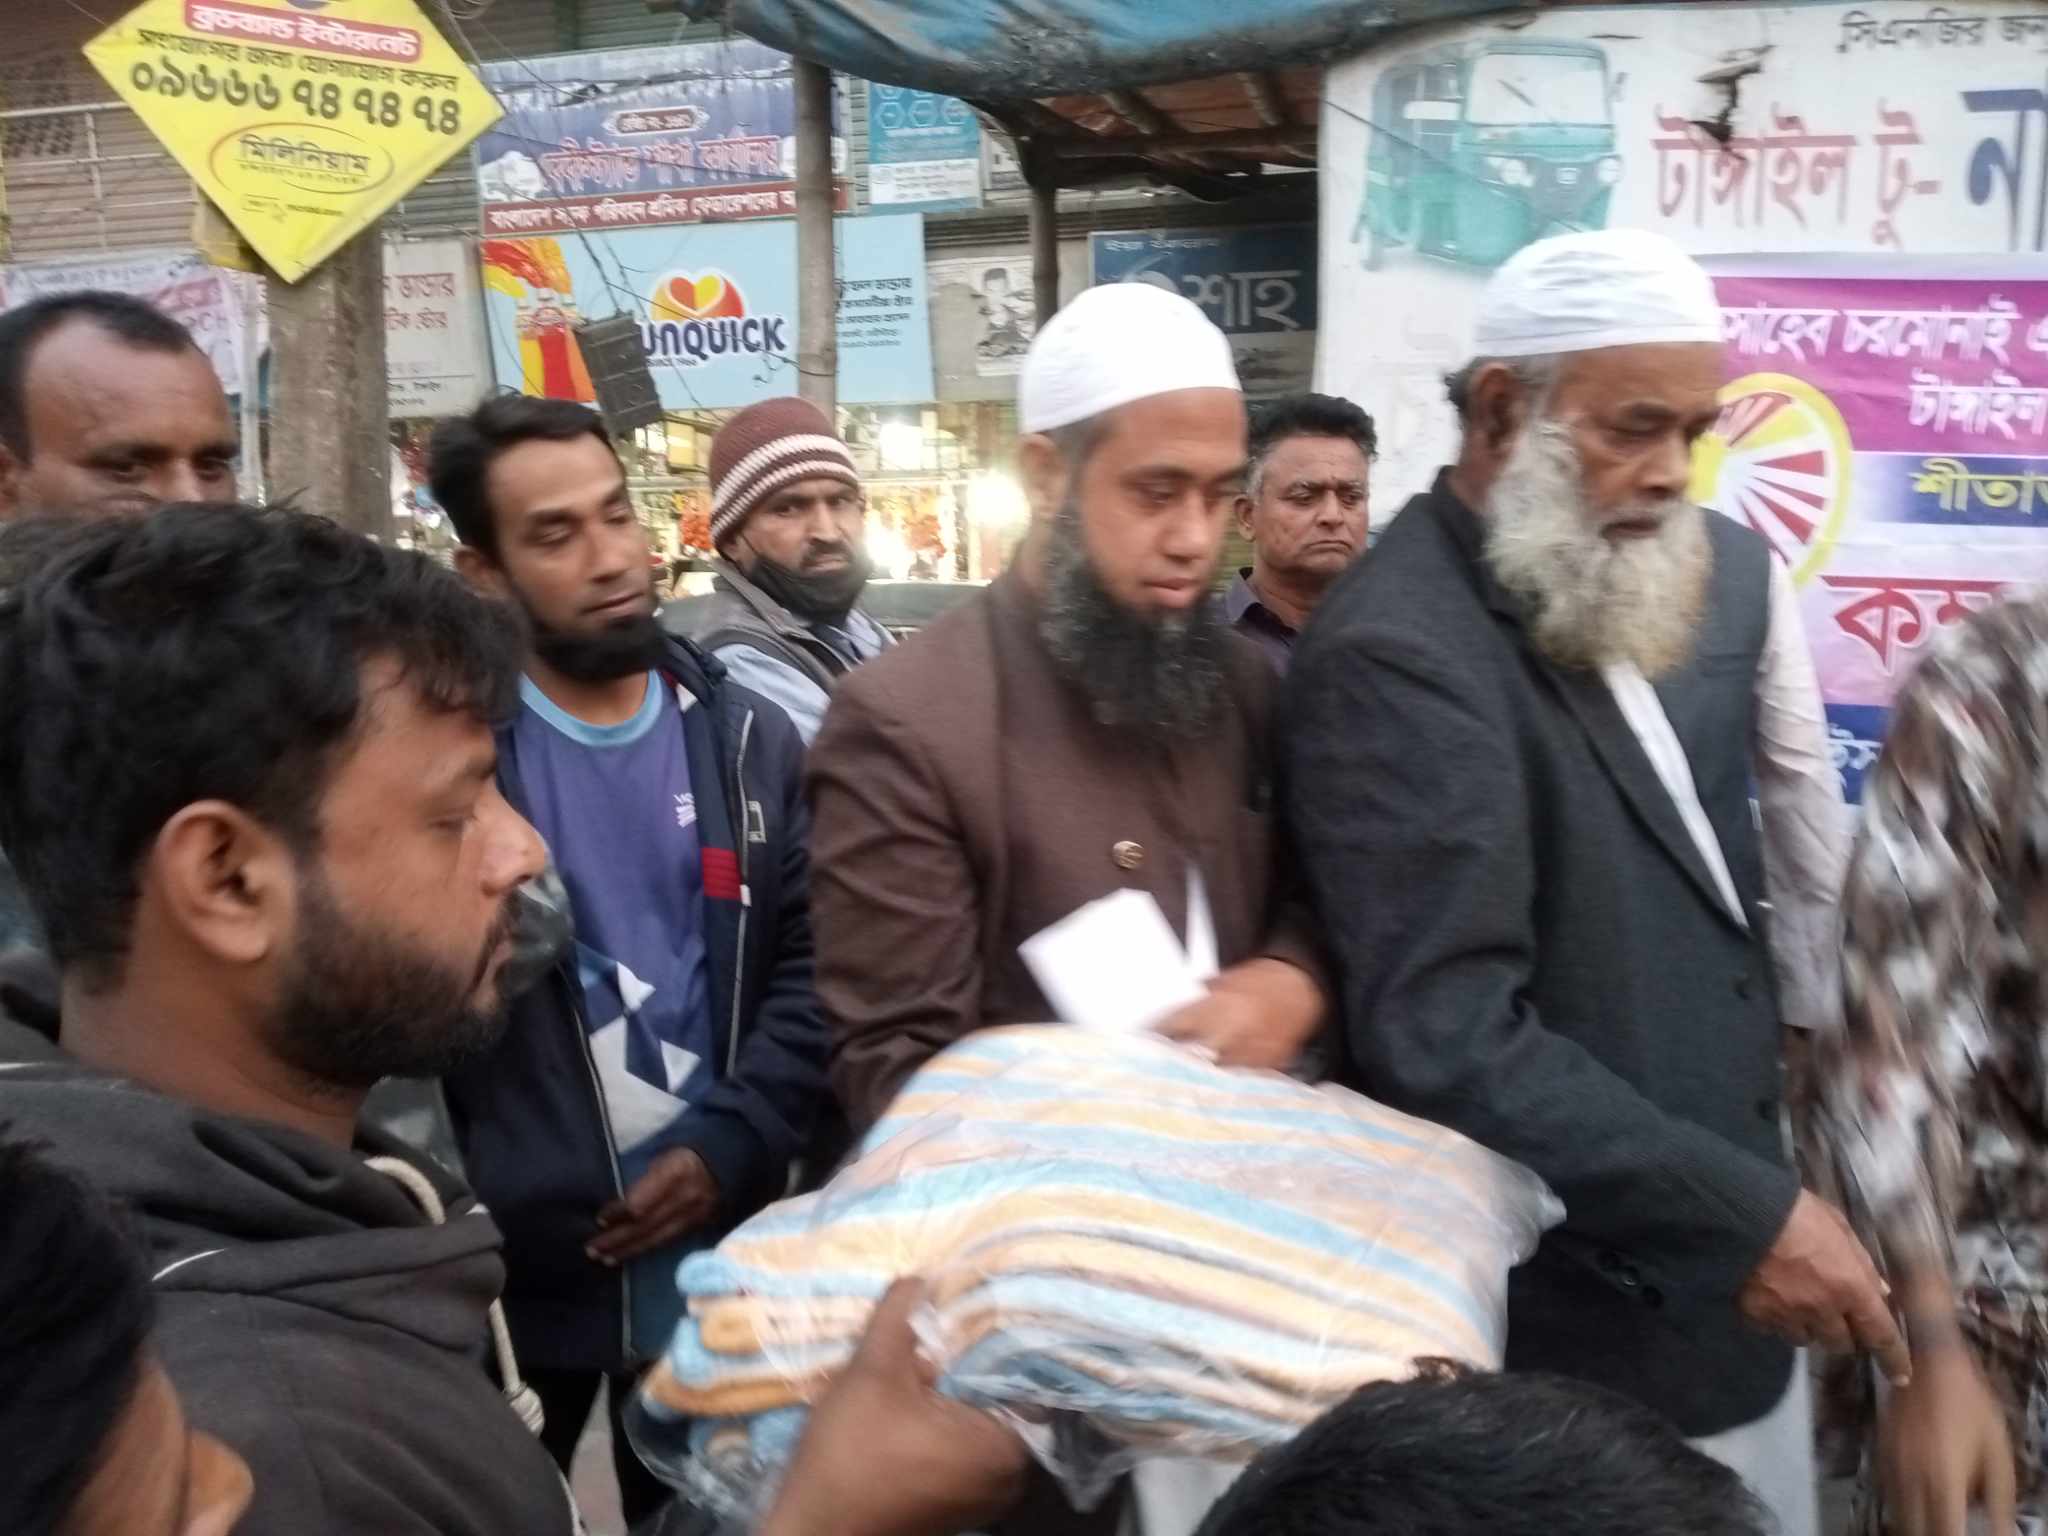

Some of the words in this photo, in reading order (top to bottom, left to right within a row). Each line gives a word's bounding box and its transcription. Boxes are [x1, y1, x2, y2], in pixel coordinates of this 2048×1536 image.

[131, 55, 281, 111] ০৯৬৬৬
[292, 79, 341, 120] ৭৪
[353, 87, 401, 128] ৭৪
[413, 95, 460, 136] ৭৪
